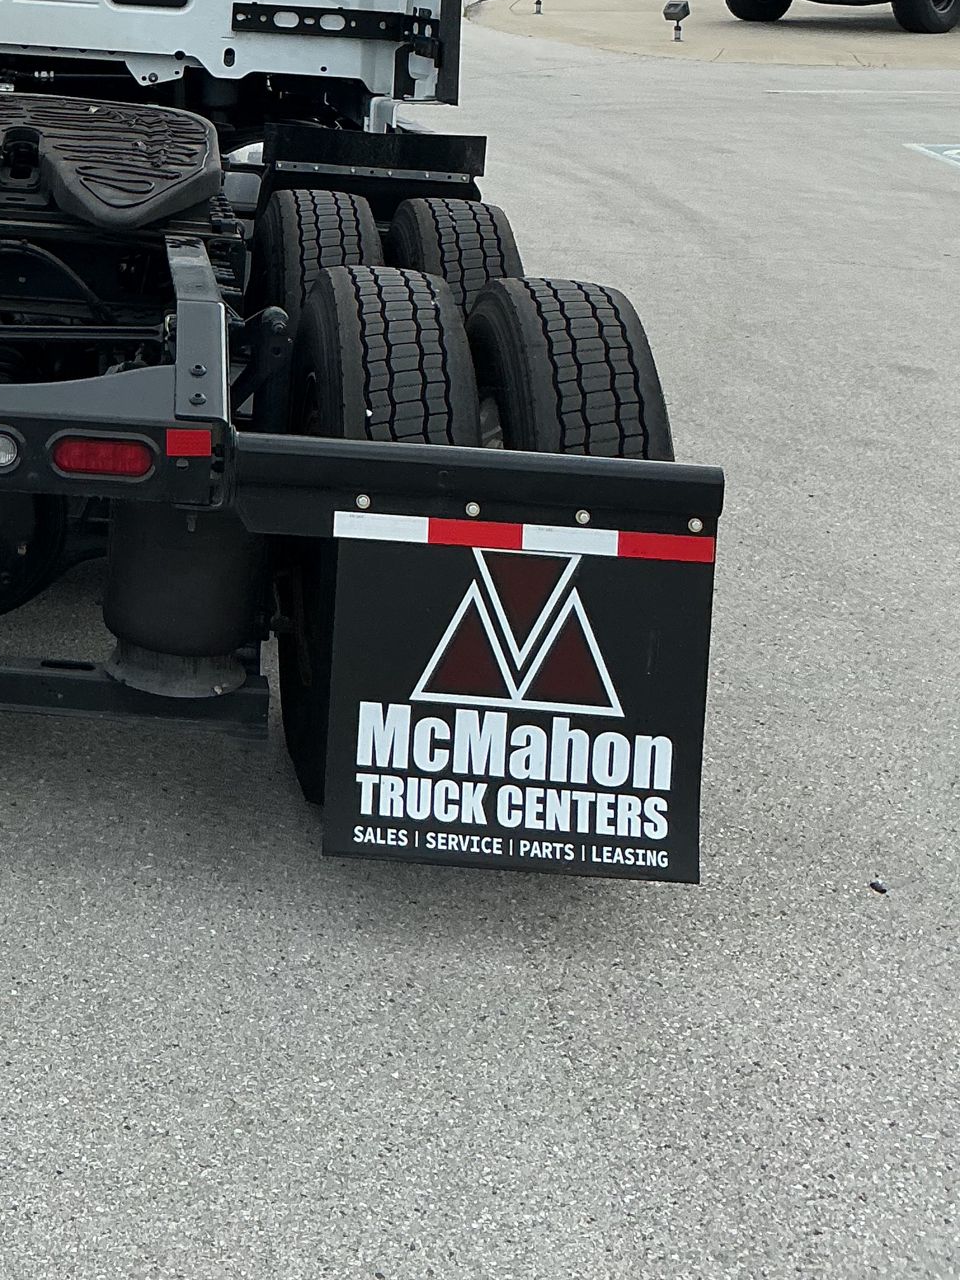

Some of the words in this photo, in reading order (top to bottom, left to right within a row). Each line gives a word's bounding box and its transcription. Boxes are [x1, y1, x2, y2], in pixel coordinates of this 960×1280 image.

[356, 700, 673, 791] McMahon
[355, 772, 489, 826] TRUCK
[496, 784, 669, 840] CENTERS
[352, 825, 409, 847] SALES
[425, 831, 503, 855] SERVICE
[519, 839, 575, 861] PARTS
[591, 845, 669, 868] LEASING
